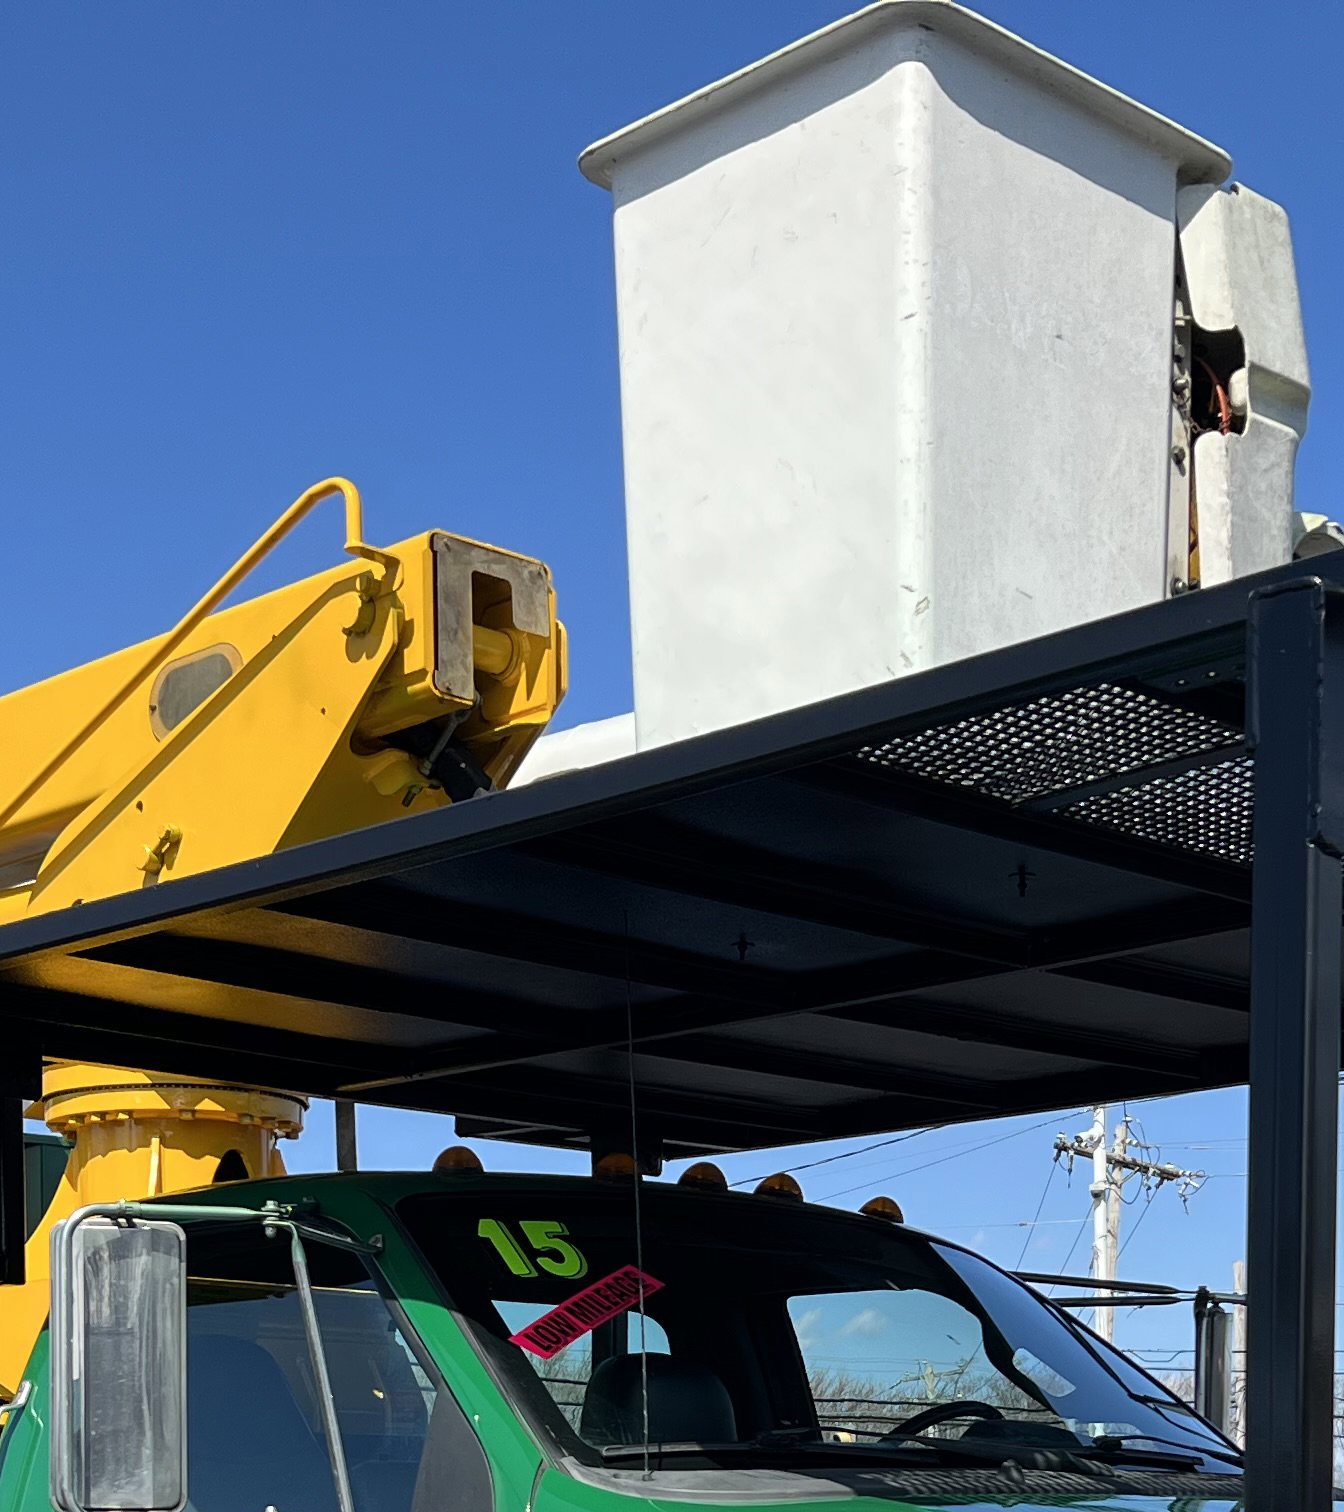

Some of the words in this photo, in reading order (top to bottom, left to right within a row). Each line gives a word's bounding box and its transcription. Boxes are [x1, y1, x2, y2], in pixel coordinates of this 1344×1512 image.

[477, 1218, 588, 1280] 15
[524, 1315, 579, 1352] LOW
[567, 1270, 654, 1325] MILEAGE
